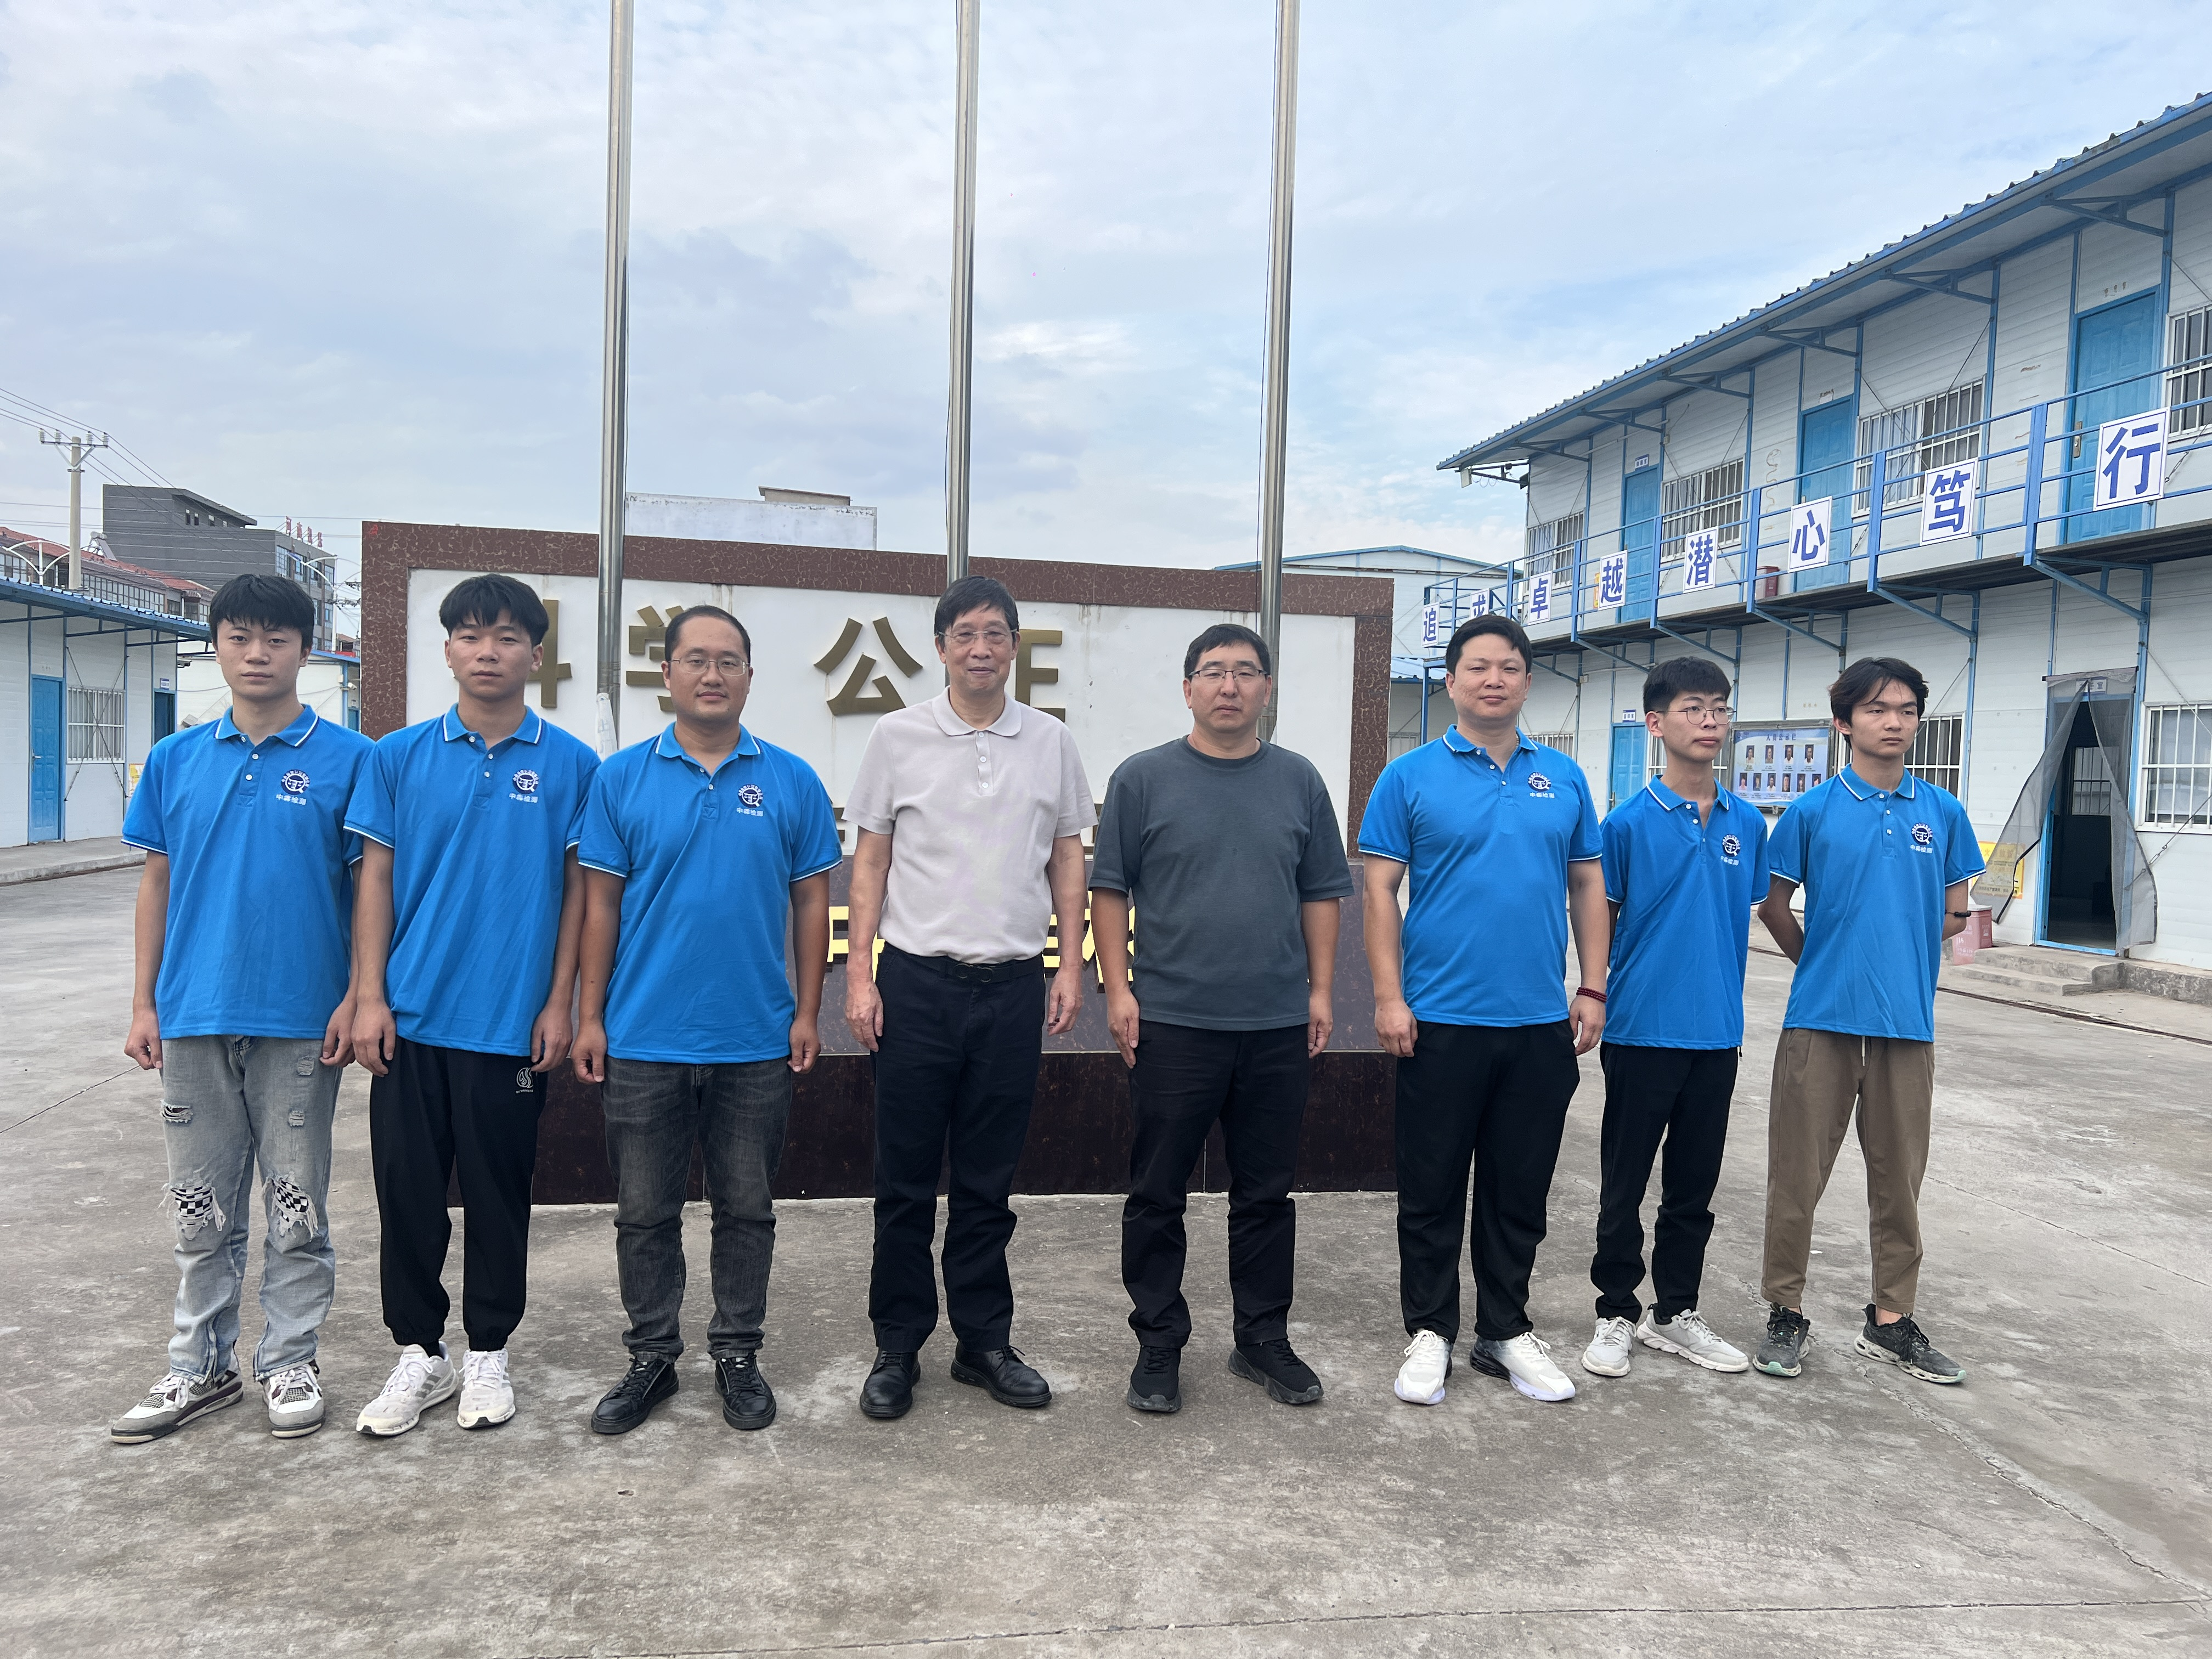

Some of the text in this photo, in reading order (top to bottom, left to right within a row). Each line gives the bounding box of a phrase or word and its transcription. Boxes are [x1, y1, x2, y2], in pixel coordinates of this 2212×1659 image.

[1423, 607, 1436, 641] 追
[1530, 578, 1549, 618] 卓
[1601, 558, 1624, 603] 越
[1686, 534, 1713, 586] 潜
[1792, 511, 1826, 561] 心
[1928, 470, 1971, 532] 笃
[2102, 424, 2162, 499] 行
